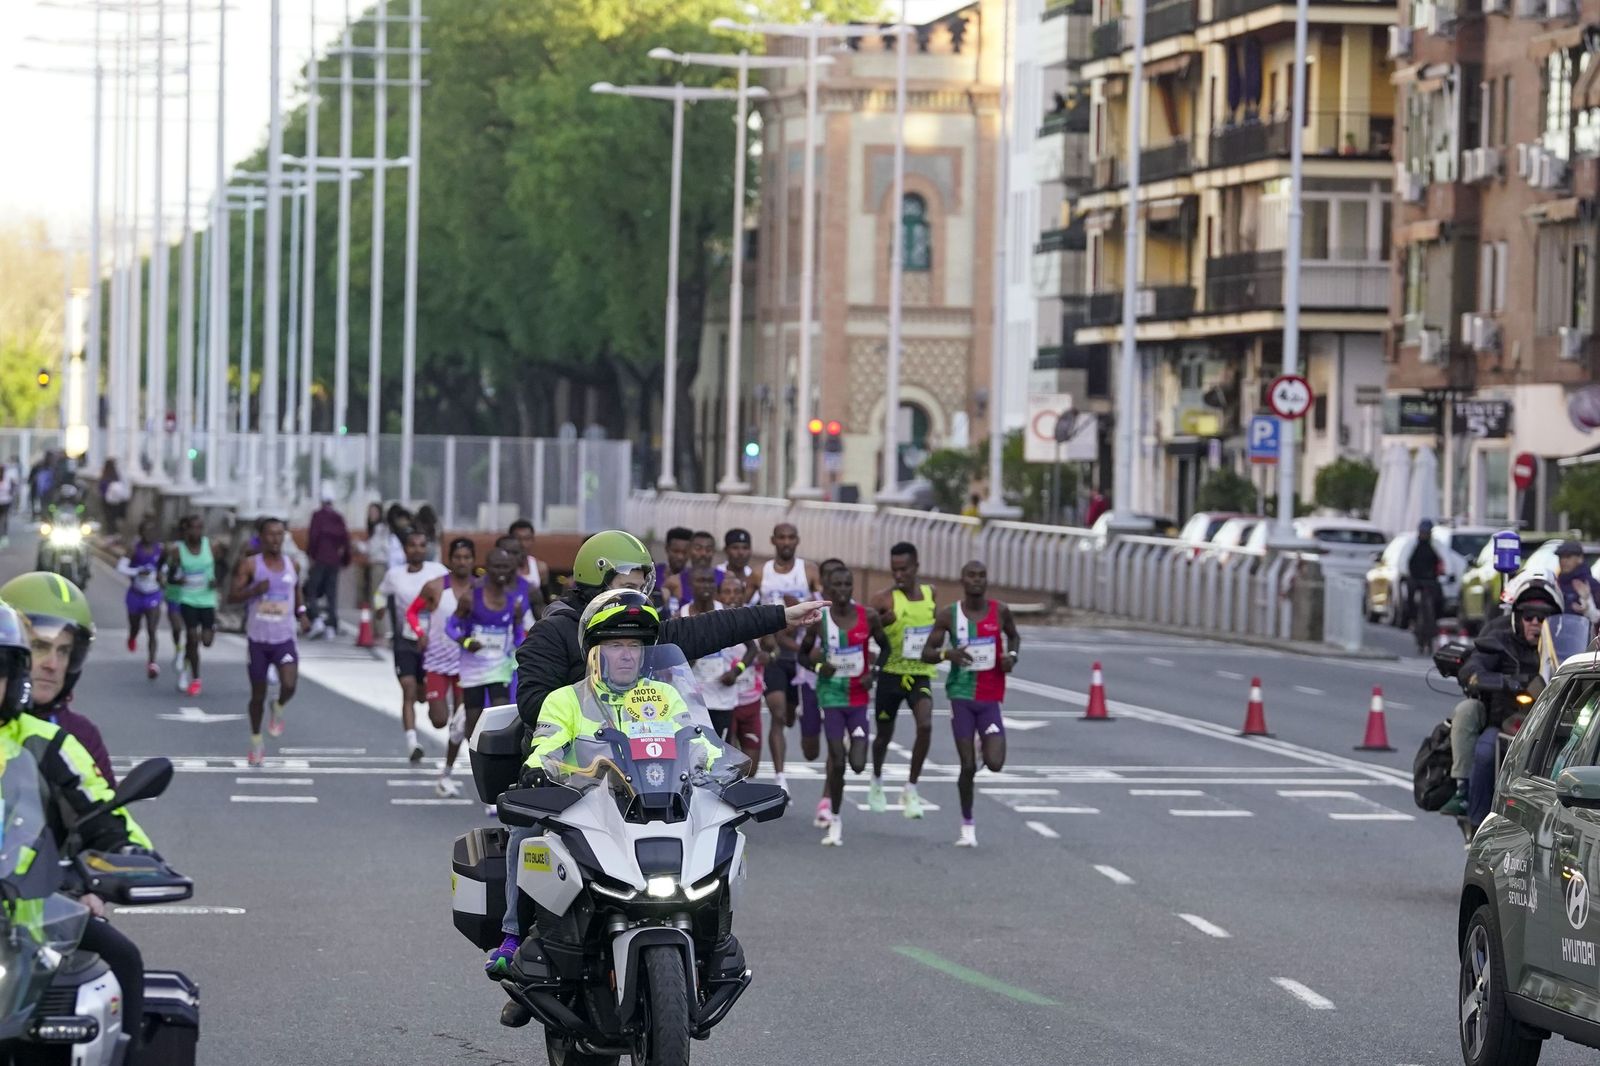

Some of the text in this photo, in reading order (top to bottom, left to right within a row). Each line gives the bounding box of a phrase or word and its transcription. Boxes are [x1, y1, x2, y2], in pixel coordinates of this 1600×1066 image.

[1253, 420, 1274, 447] P
[631, 695, 663, 703] ENLACE
[633, 688, 657, 696] MOTO
[626, 706, 641, 719] COTA
[659, 703, 670, 717] CERO
[1510, 857, 1528, 873] ZURICH
[1509, 891, 1527, 906] SEVILLA
[1561, 937, 1596, 967] HYUNDAI
